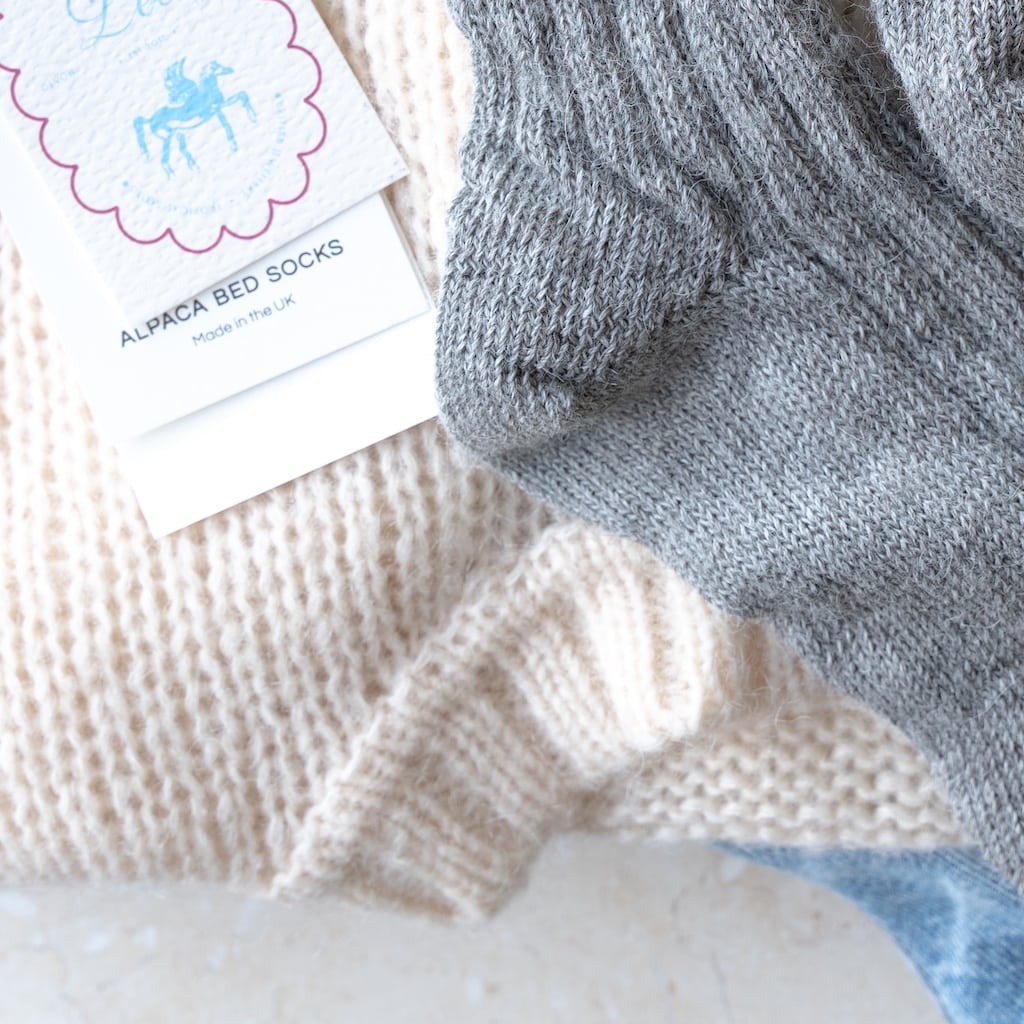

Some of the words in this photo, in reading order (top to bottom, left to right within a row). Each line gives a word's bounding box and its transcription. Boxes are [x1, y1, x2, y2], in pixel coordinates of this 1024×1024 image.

[120, 298, 208, 347] ALPACA
[212, 275, 260, 307] BED
[266, 238, 344, 283] SOCKS
[192, 322, 233, 347] Made
[234, 315, 248, 329] in
[248, 306, 273, 323] the
[273, 293, 296, 312] UK
